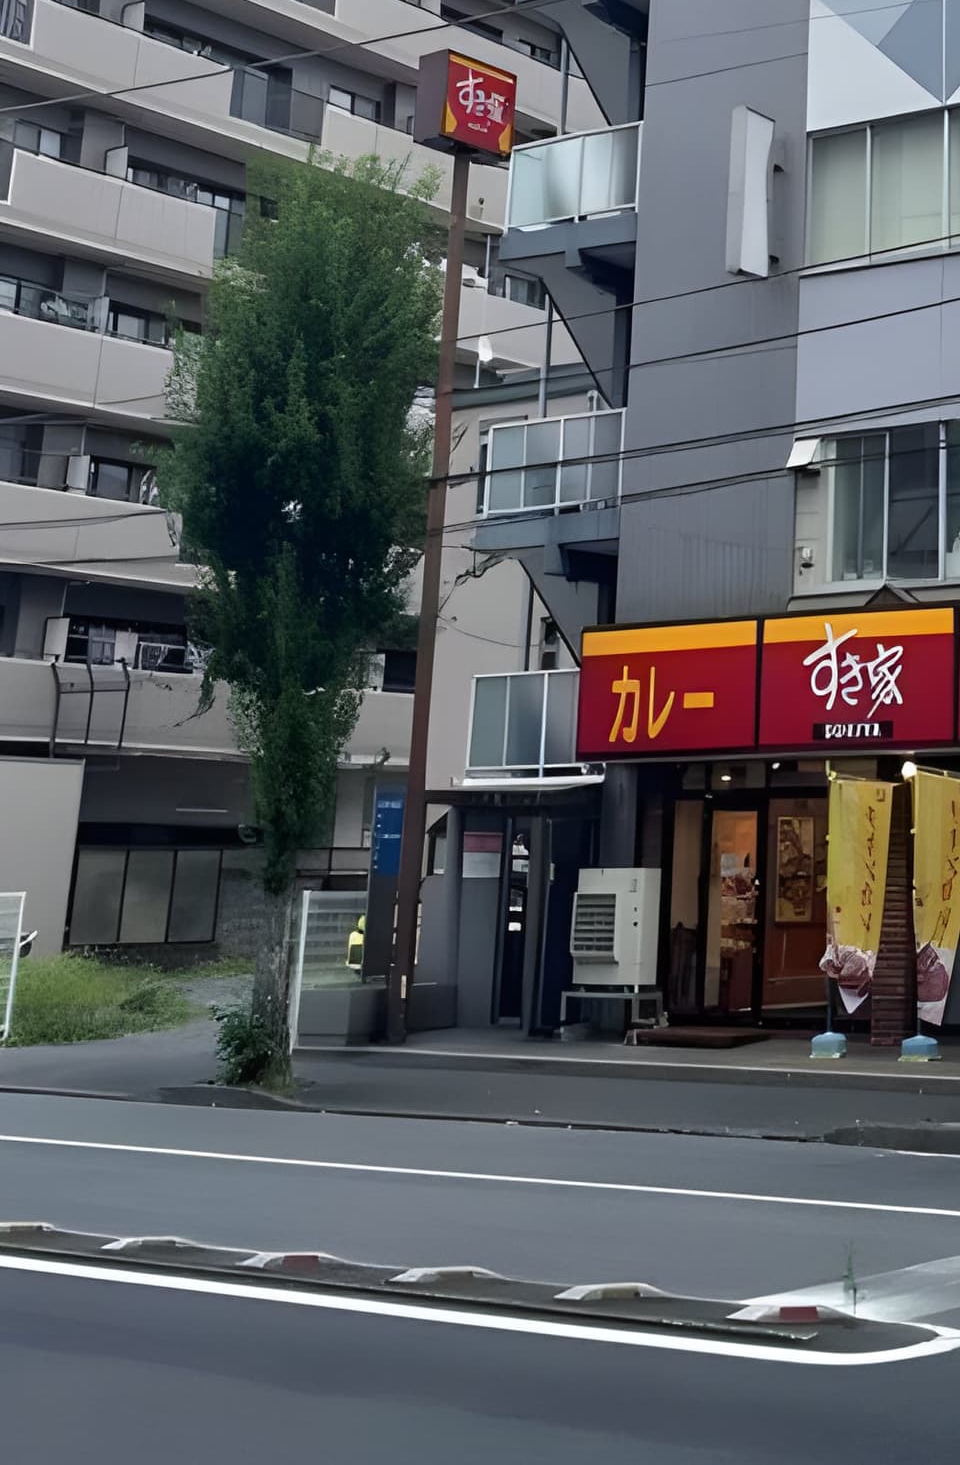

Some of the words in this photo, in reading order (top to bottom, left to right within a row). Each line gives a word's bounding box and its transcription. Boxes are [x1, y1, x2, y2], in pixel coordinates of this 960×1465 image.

[608, 665, 715, 743] カレー
[802, 621, 904, 719] すき家
